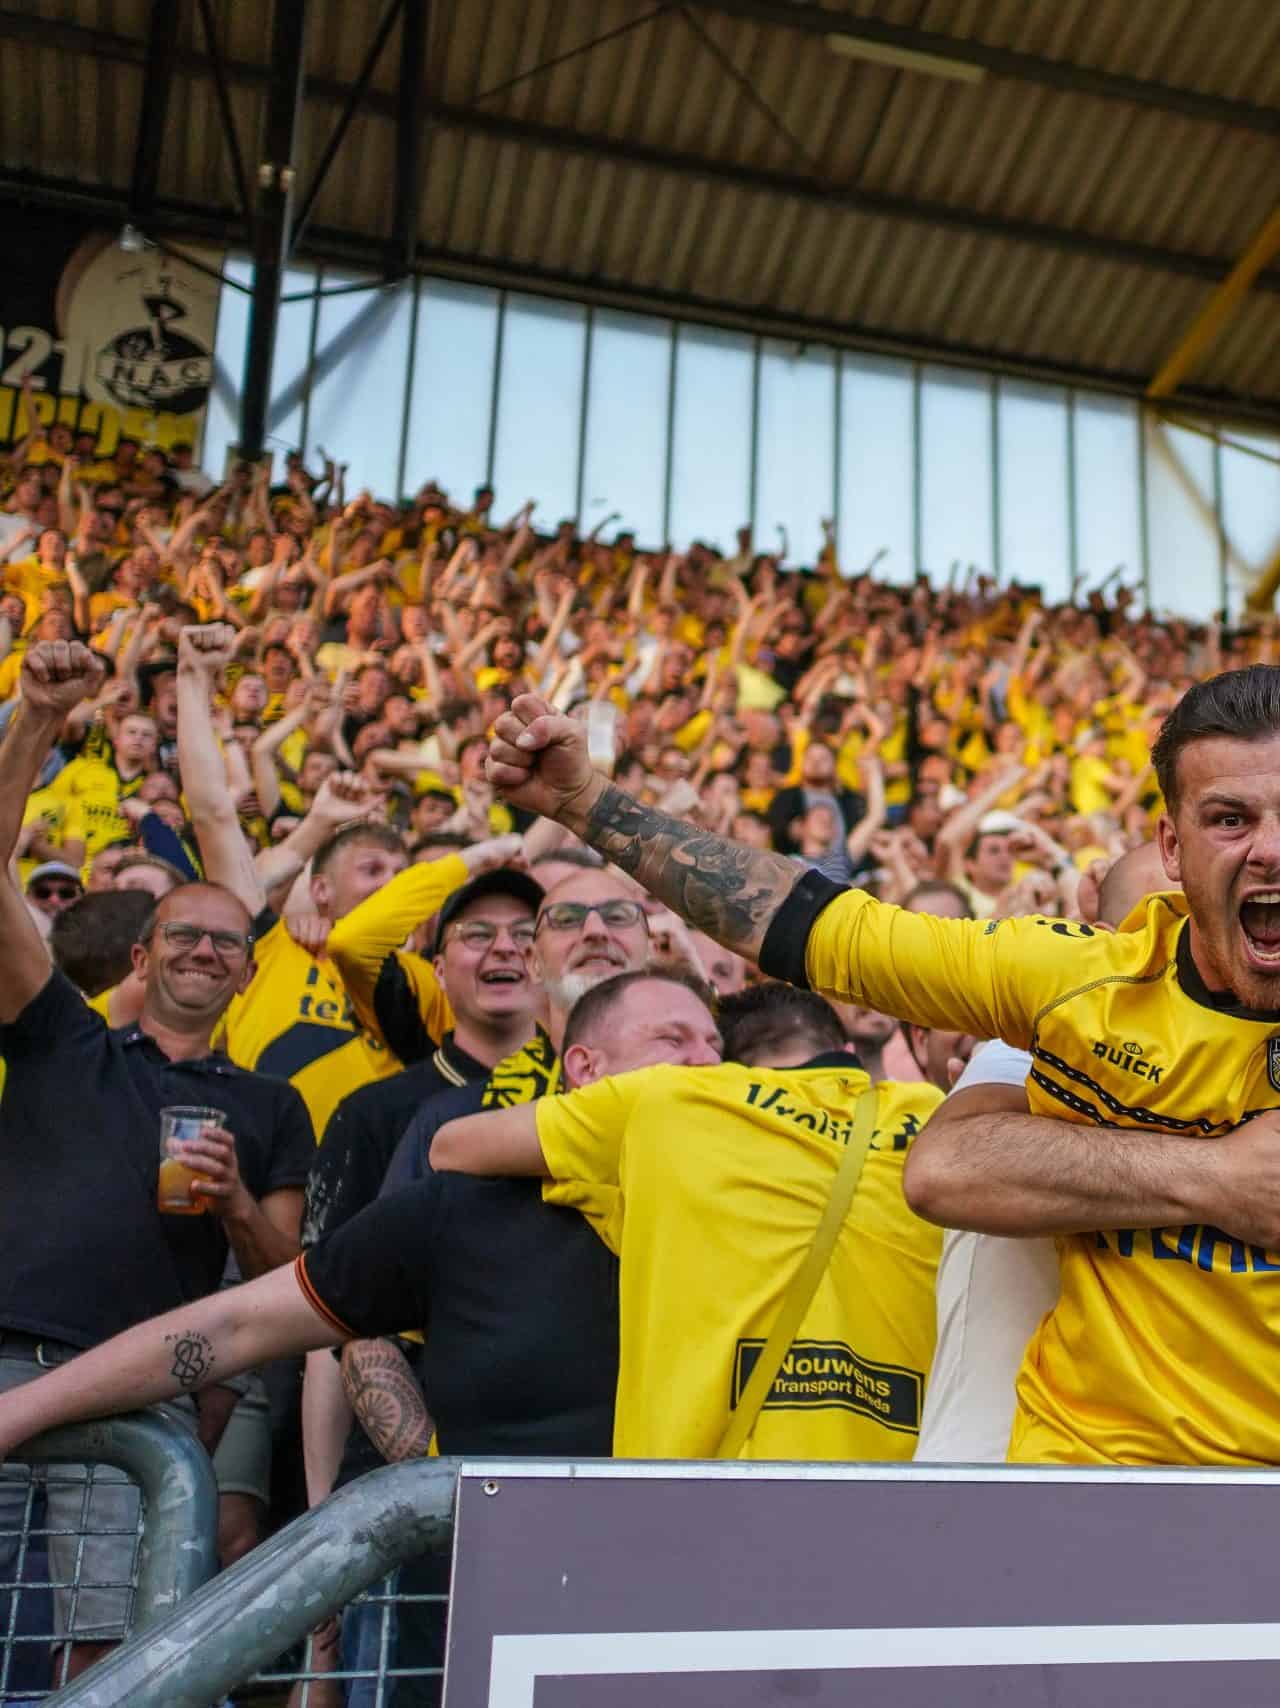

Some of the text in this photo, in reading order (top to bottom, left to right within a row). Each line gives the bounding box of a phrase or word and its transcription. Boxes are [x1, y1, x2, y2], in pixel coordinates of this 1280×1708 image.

[0, 325, 82, 393] 21
[774, 1377, 851, 1395] Transport
[782, 1354, 891, 1397] Nouwens
